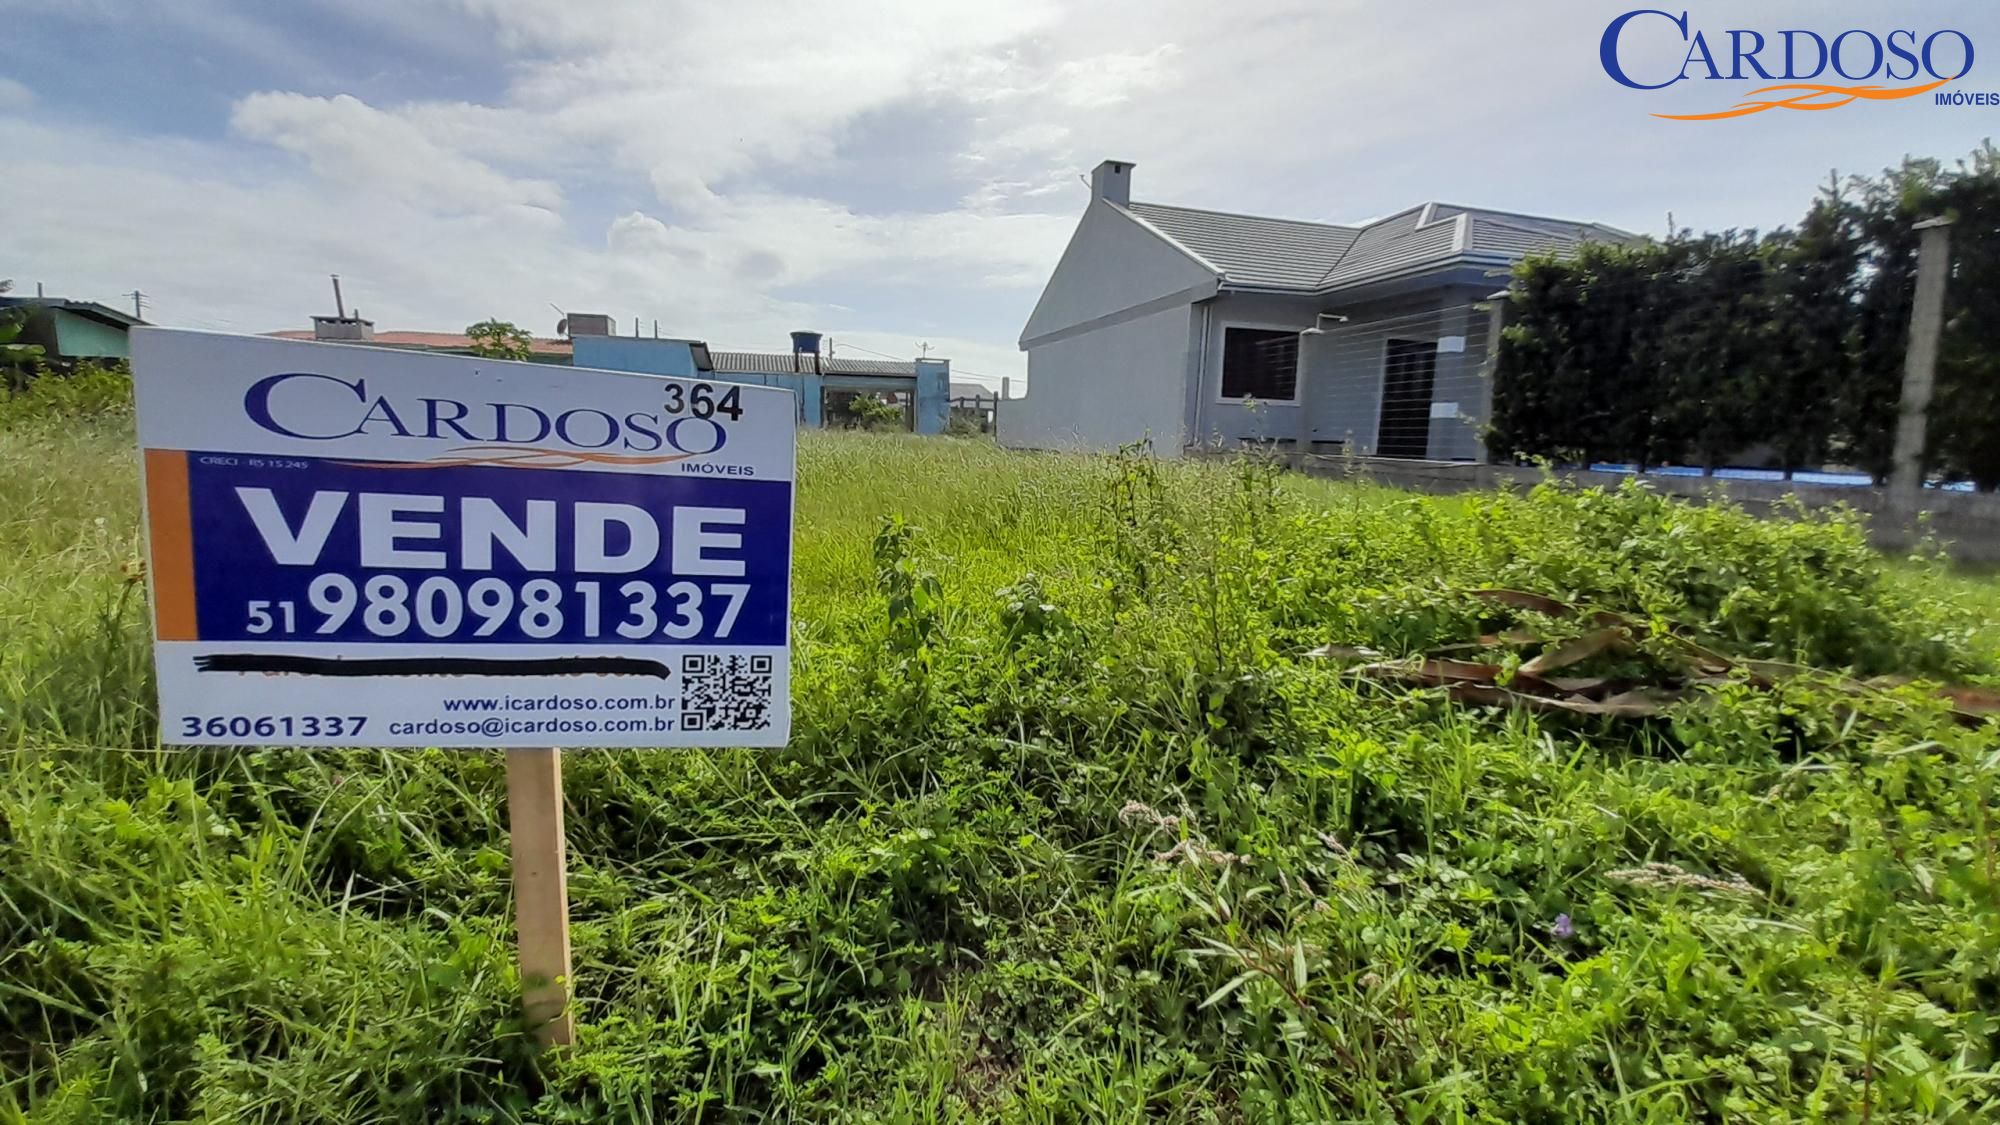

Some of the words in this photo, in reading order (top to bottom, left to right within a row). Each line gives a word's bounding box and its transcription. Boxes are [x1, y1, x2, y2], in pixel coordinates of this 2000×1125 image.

[664, 383, 743, 421] 364
[245, 373, 727, 455] CARDOSO
[200, 456, 239, 466] CRECI
[681, 462, 754, 476] IMÓVEIS
[235, 486, 747, 576] VENDE
[246, 600, 296, 634] 51
[308, 572, 752, 639] 980981337
[443, 693, 675, 713] www.icardoso.com.br
[182, 715, 369, 738] 36061337
[389, 717, 675, 737] cardoso@icardoso.com.br
